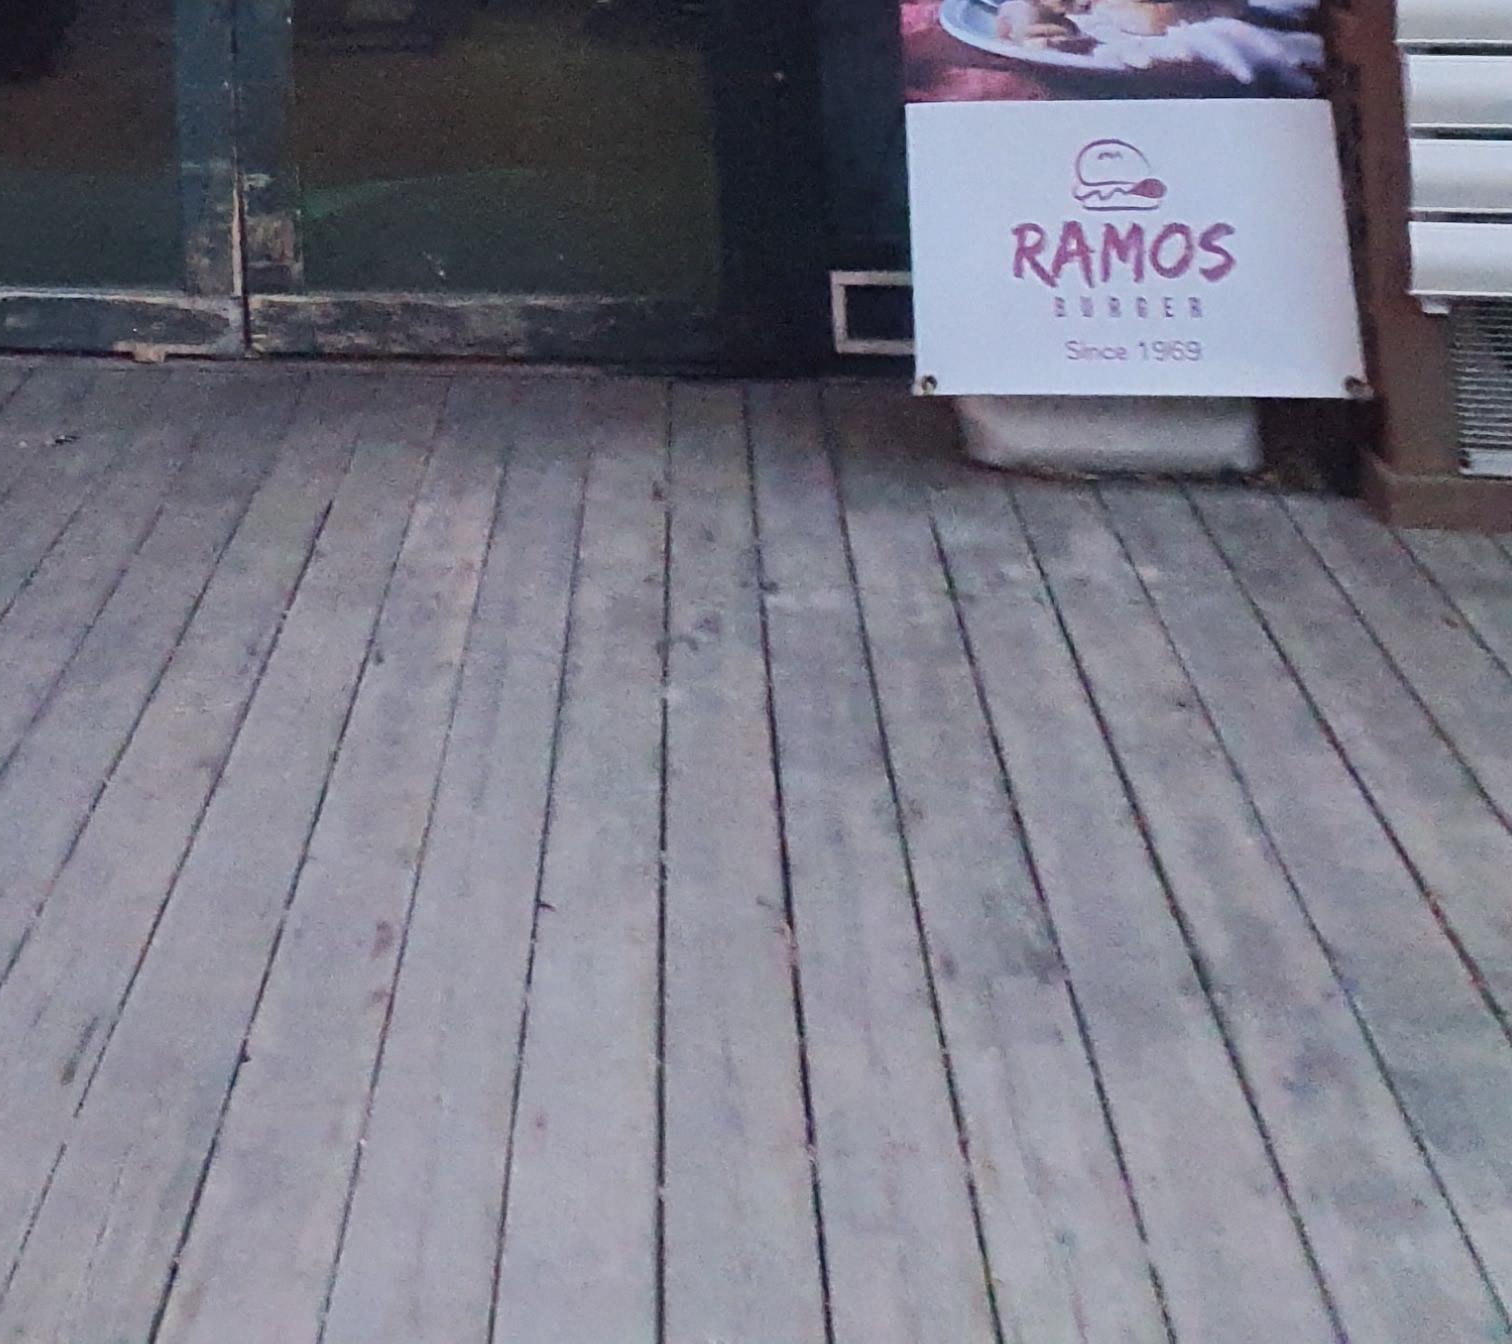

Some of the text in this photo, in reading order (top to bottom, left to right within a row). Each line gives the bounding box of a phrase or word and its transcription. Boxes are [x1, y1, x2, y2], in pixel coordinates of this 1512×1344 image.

[1011, 220, 1236, 288] RAMOS
[1053, 296, 1203, 318] BURGER
[1065, 340, 1202, 362] Since 1969
